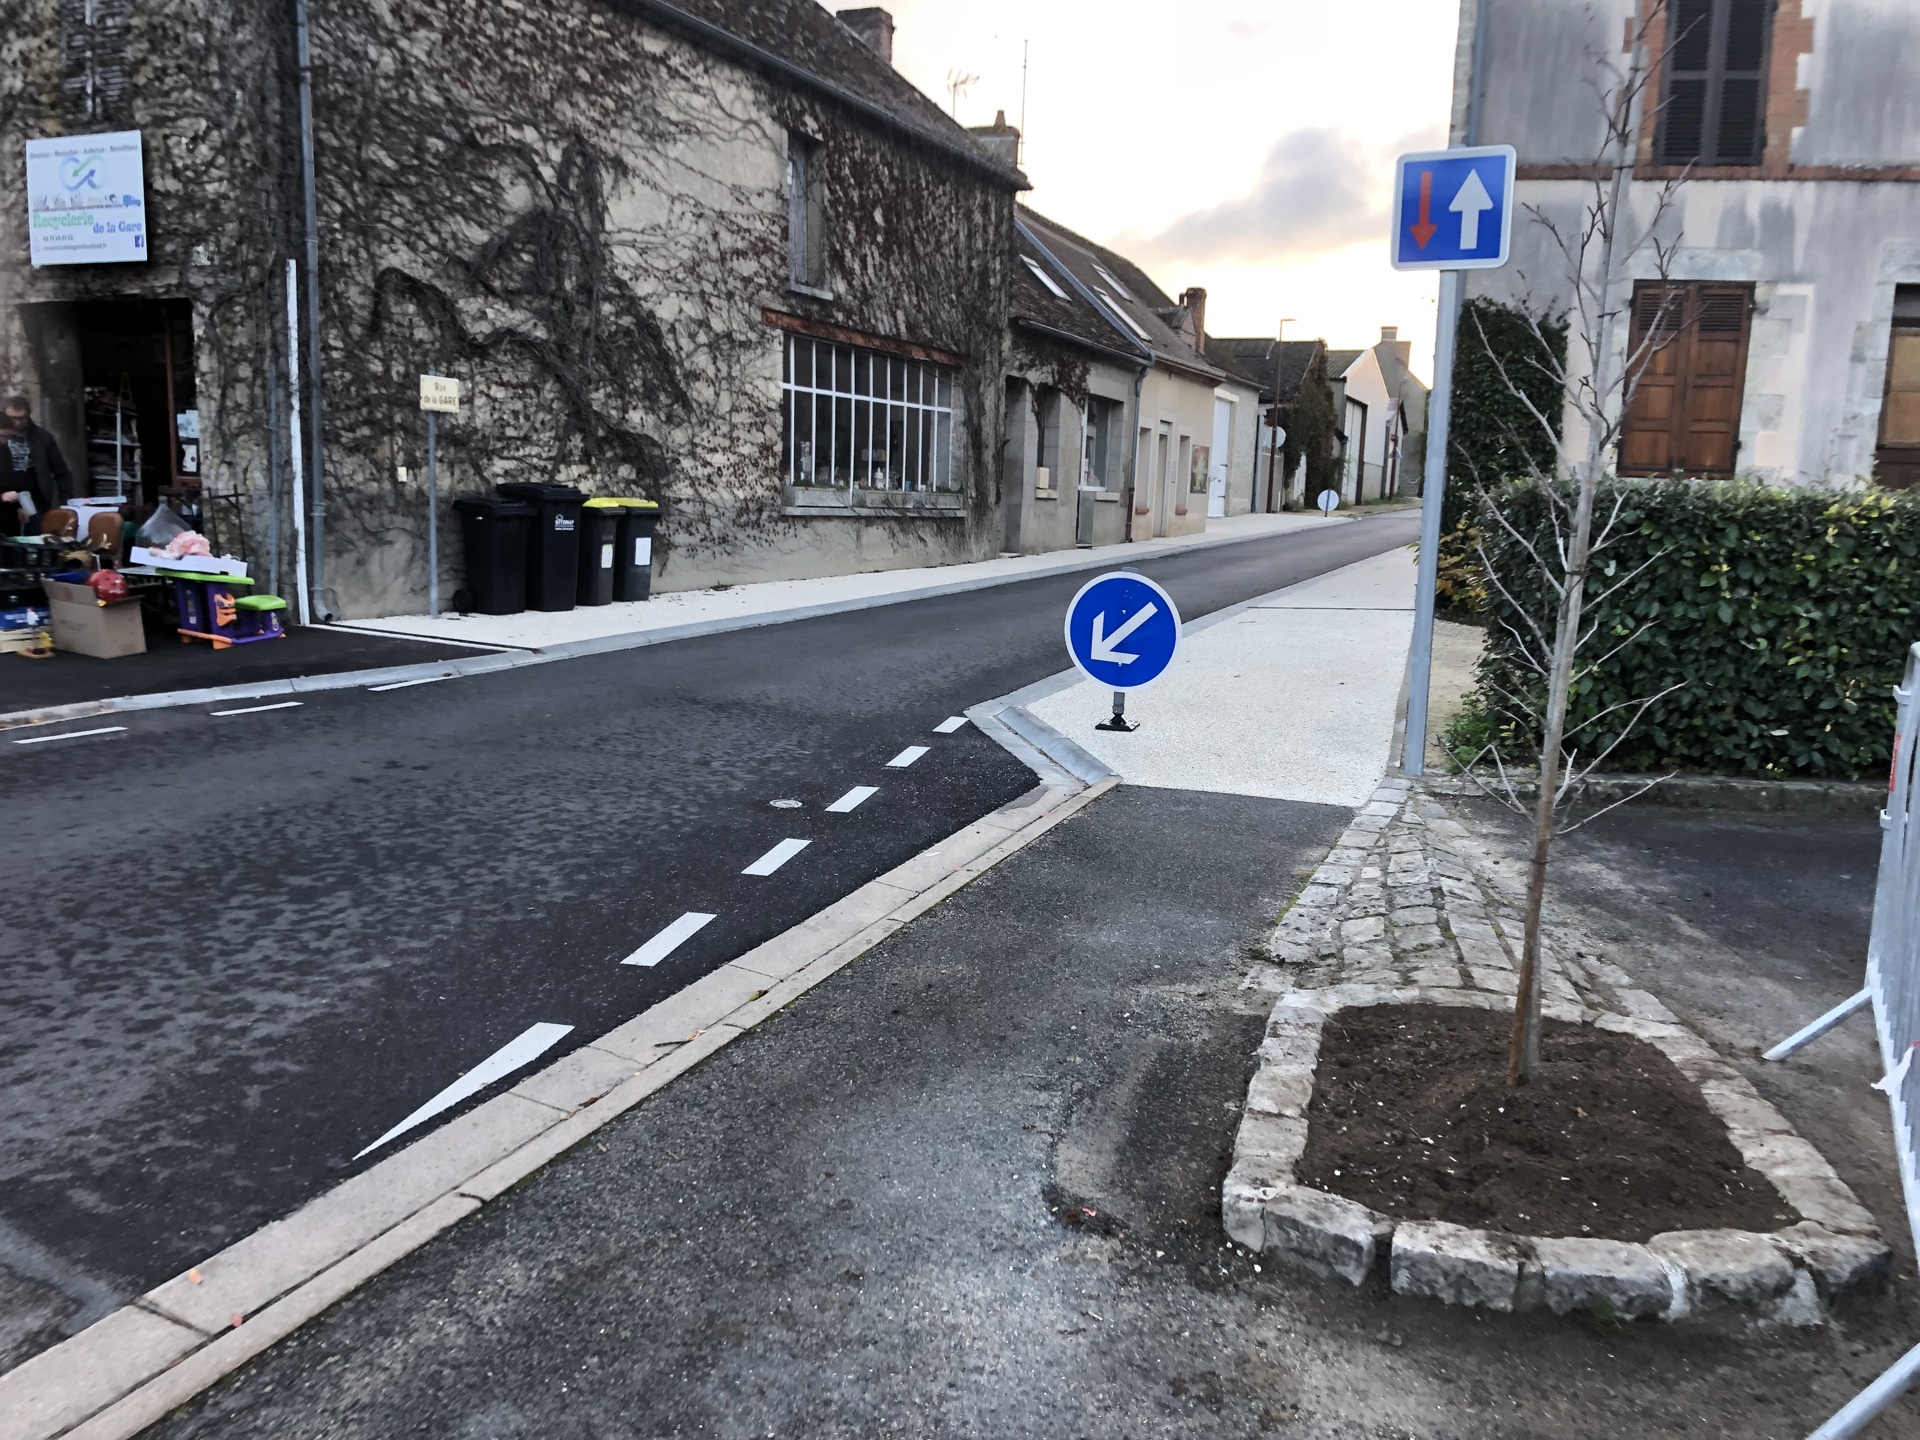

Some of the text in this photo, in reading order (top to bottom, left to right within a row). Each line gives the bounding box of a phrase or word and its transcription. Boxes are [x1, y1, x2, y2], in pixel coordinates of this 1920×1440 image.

[33, 213, 94, 229] Recyclerie
[93, 220, 142, 234] de la Gare
[439, 396, 456, 405] GARE
